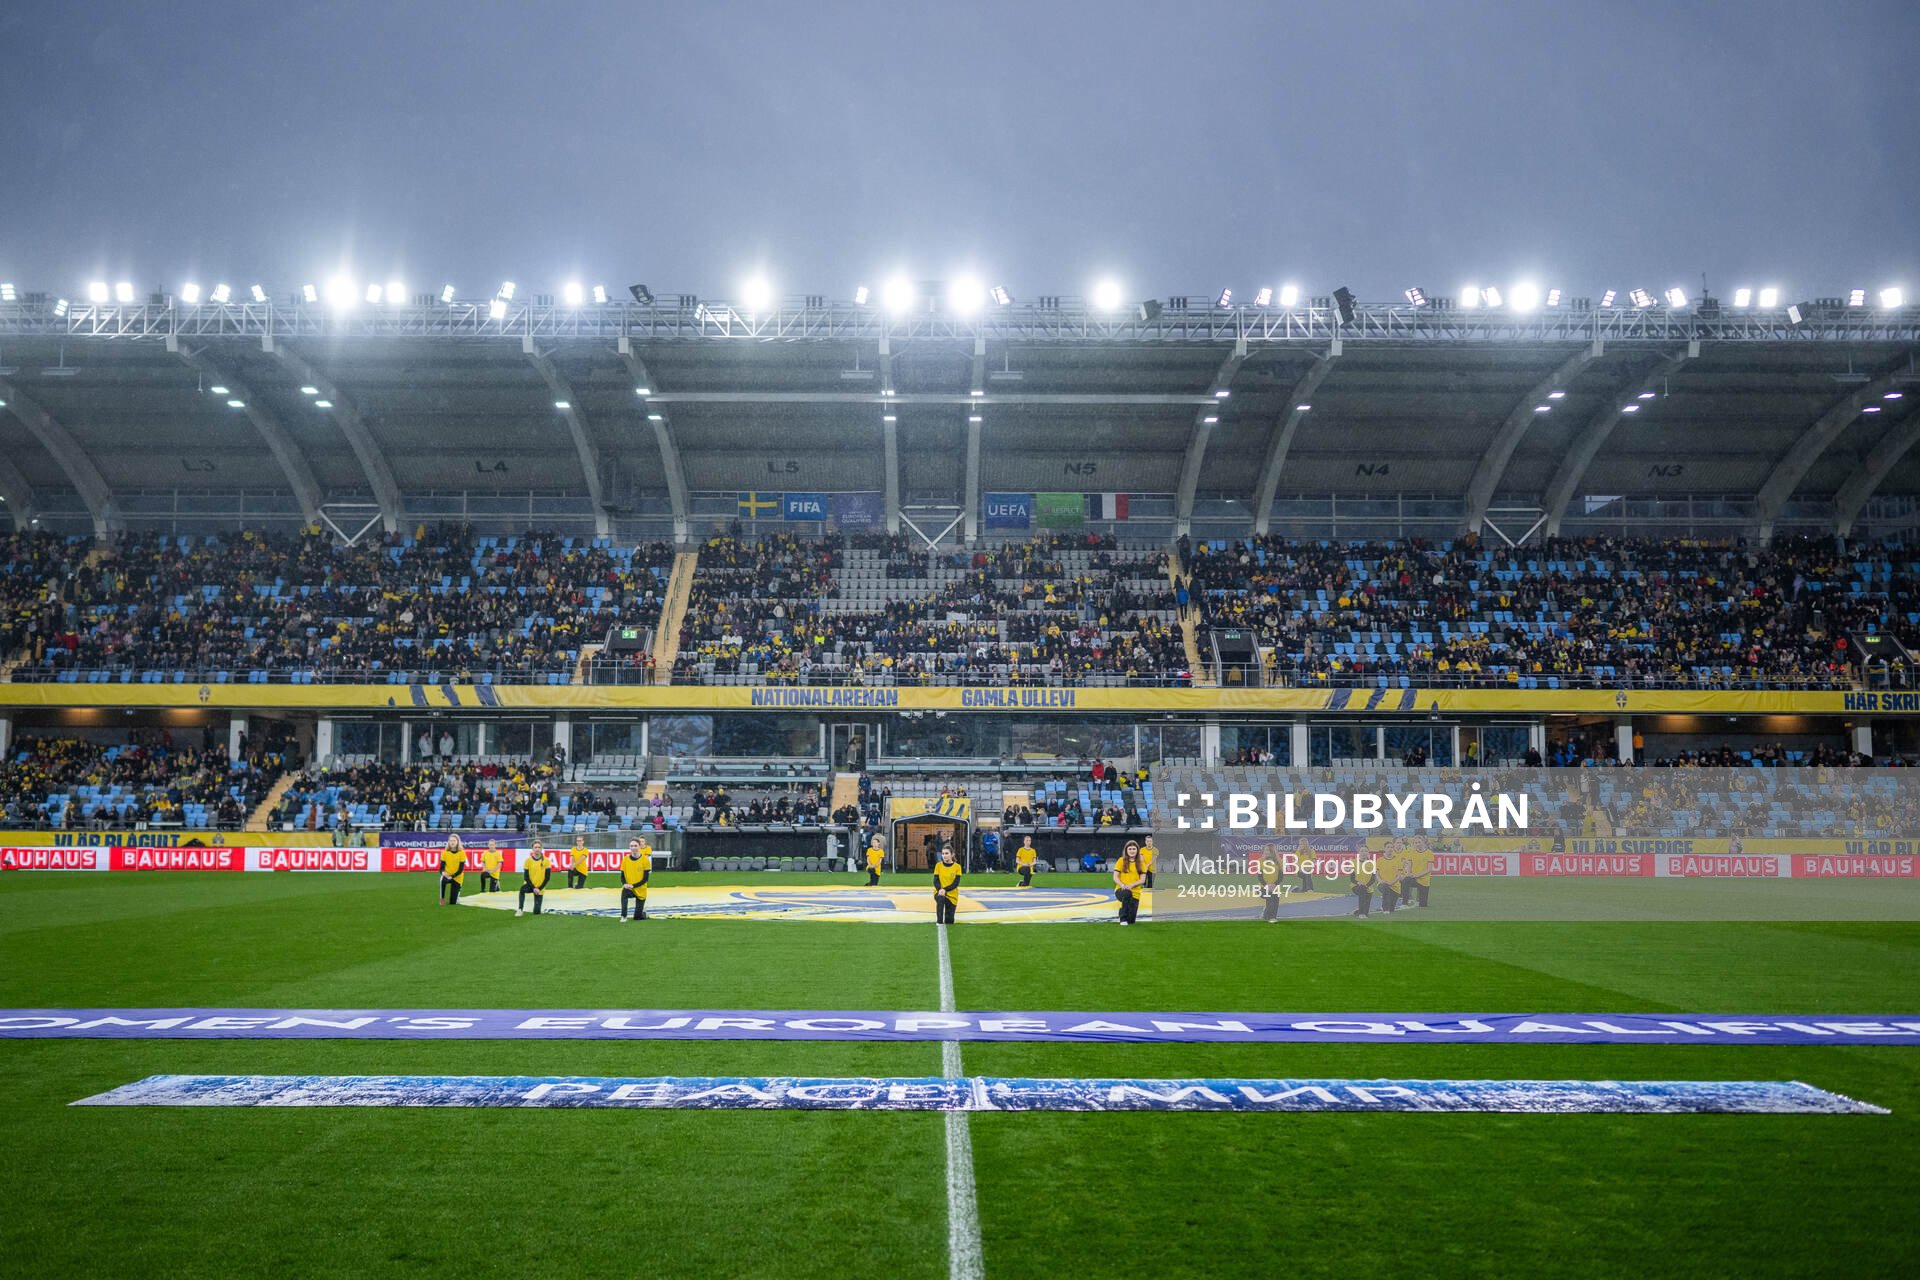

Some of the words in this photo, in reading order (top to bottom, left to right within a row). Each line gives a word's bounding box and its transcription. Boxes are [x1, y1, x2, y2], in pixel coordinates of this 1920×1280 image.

[183, 459, 216, 472] L3
[476, 461, 509, 473] L4
[767, 461, 800, 474] L5
[1063, 462, 1097, 475] N5
[1355, 463, 1390, 477] N4
[1648, 464, 1684, 477] N3
[790, 502, 821, 513] FIFA
[988, 505, 1026, 516] UEFA
[751, 688, 898, 706] NATIONALARENAN
[961, 689, 1019, 706] GAMLA
[1022, 689, 1075, 706] ULLEVI
[1845, 692, 1879, 710] HÄR
[124, 850, 232, 867] BAUHAUS
[260, 850, 367, 868] BAUHAUS
[1533, 856, 1641, 873] BAUHAUS
[1670, 857, 1776, 874] BAUHAUS
[1805, 858, 1912, 875] BAUHAUS
[513, 1017, 1254, 1033] EUROPEAN
[520, 1083, 960, 1101] PEACE
